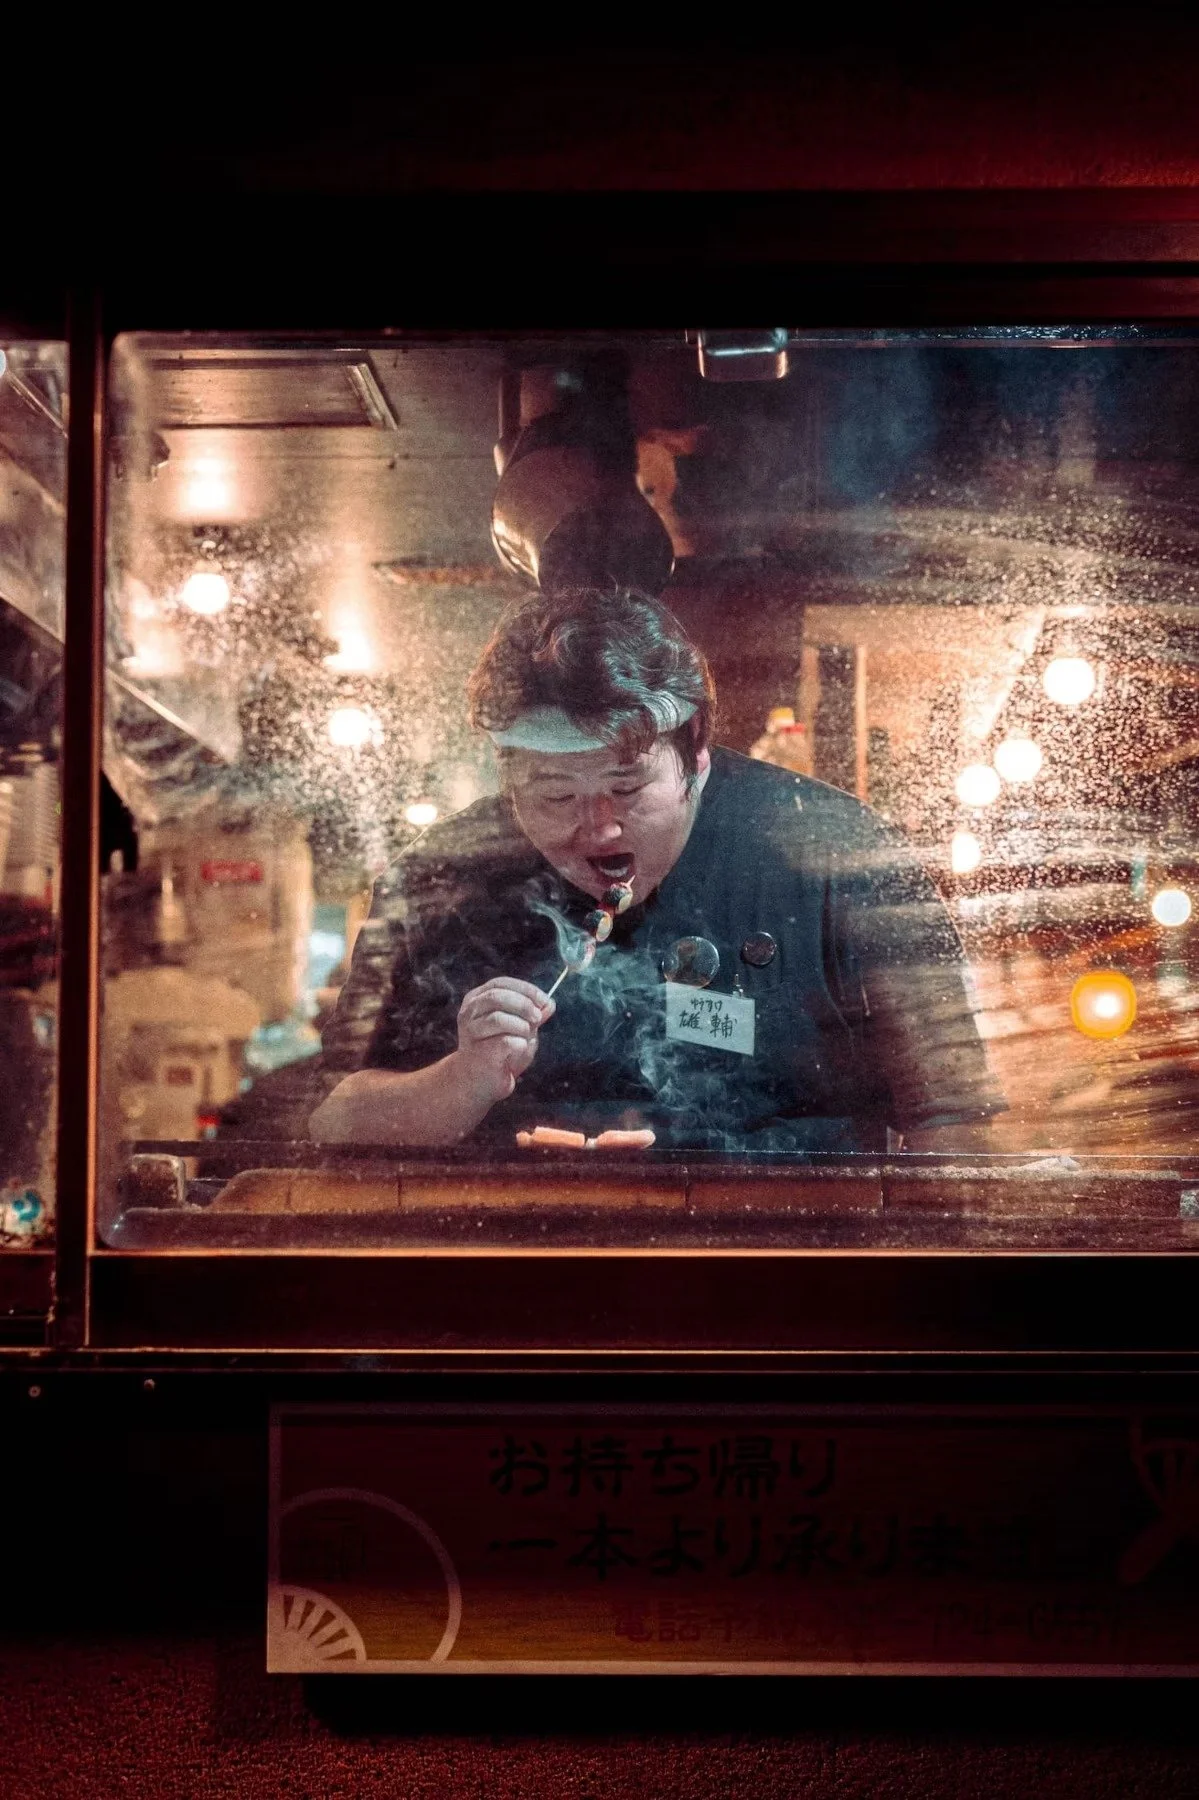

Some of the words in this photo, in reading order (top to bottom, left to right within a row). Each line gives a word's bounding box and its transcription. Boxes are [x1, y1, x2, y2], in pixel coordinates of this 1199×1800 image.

[489, 1435, 837, 1501] お持ち帰り
